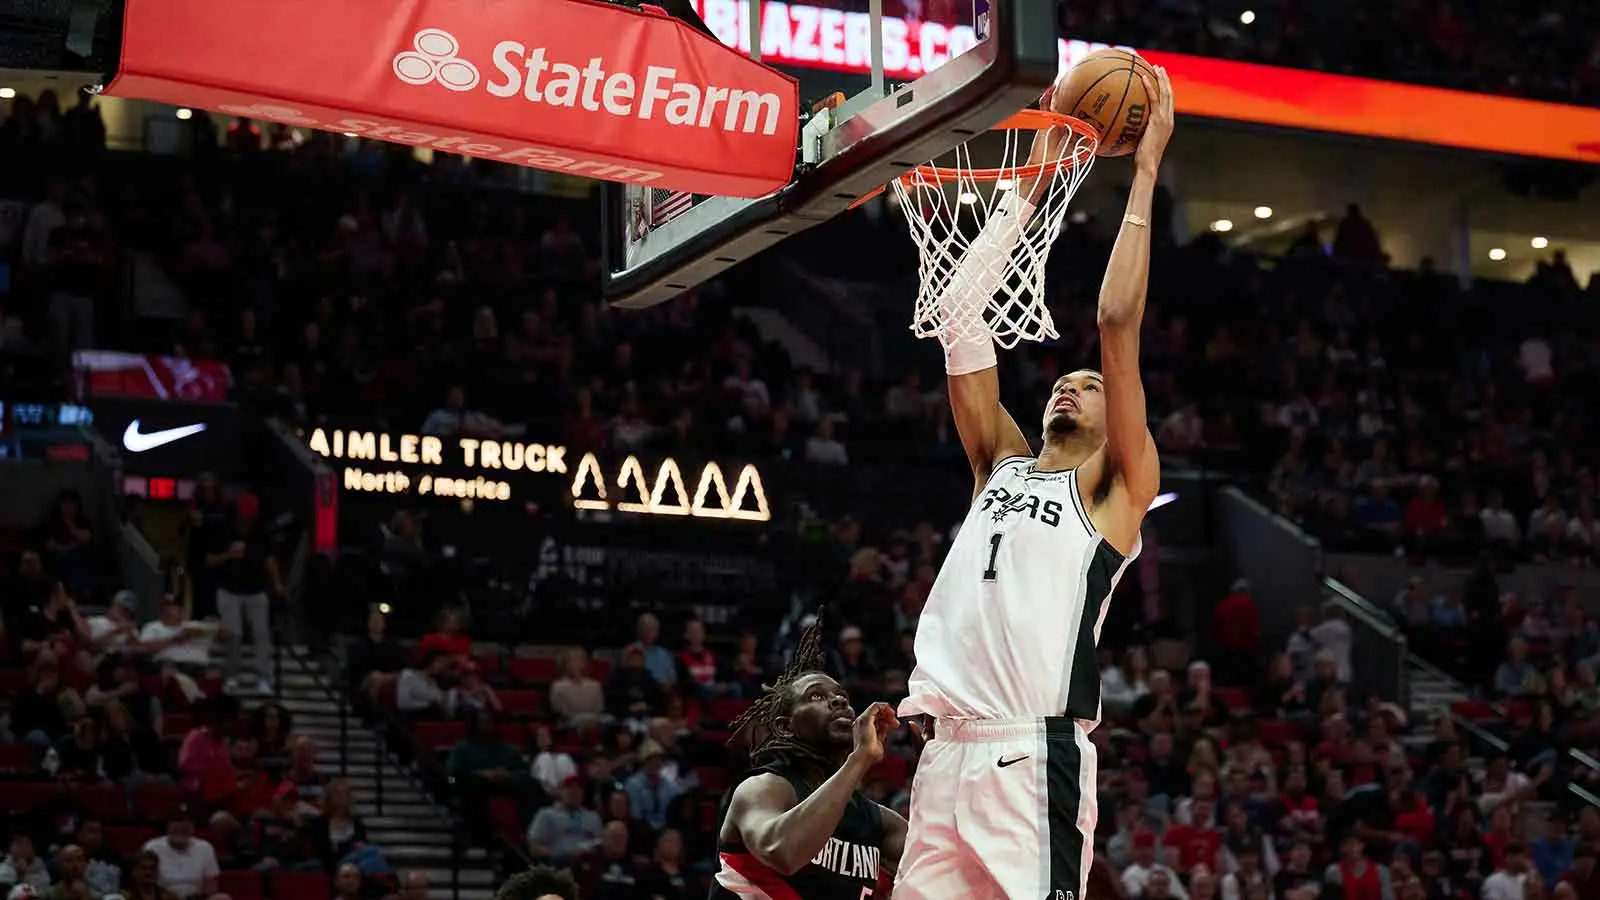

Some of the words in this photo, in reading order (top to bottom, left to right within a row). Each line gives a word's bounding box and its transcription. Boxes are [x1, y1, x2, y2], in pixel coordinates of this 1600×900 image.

[459, 438, 568, 474] TRUCK
[344, 466, 410, 493] North
[982, 532, 1004, 582] 1
